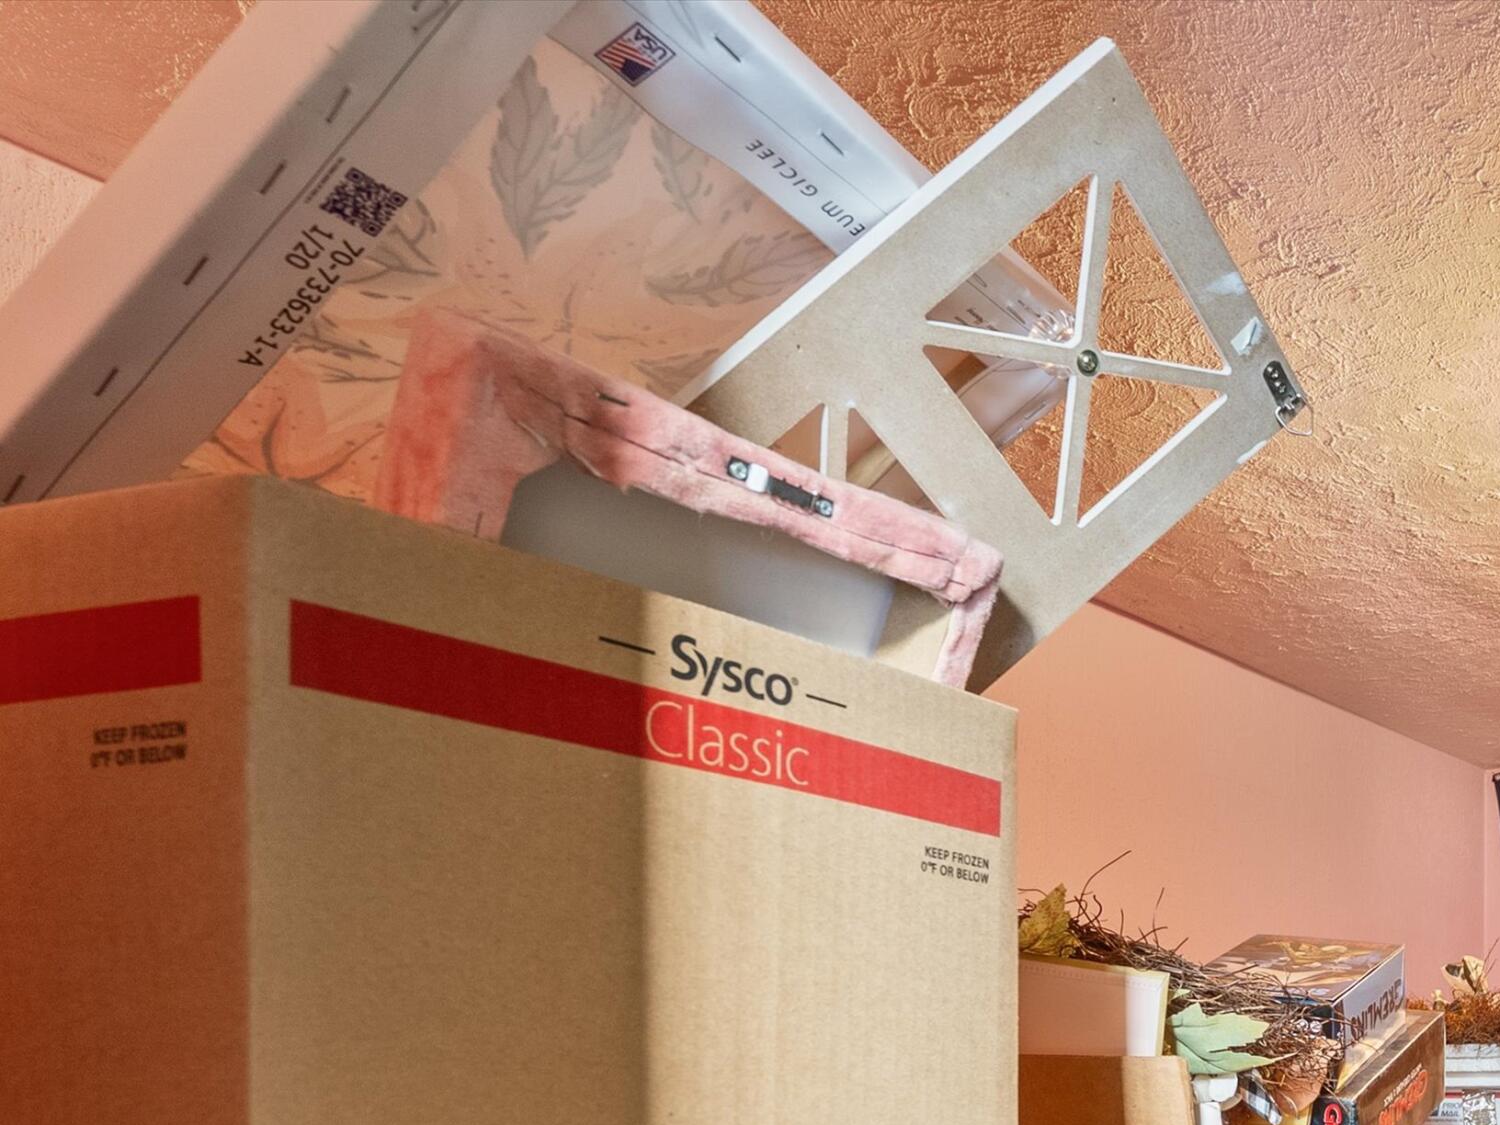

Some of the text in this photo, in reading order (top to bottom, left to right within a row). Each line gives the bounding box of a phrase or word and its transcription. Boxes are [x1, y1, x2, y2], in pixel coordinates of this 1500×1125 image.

[633, 28, 669, 61] USA
[745, 138, 819, 198] GICLEE
[284, 224, 334, 270] 1/20
[237, 239, 365, 367] 70-733623-1-A
[670, 634, 793, 706] Sysco
[92, 726, 128, 745] KEEP
[645, 701, 810, 786] Classic
[924, 846, 990, 870] KEEP FROZEN
[940, 865, 954, 877] OR
[956, 866, 990, 885] BELOW
